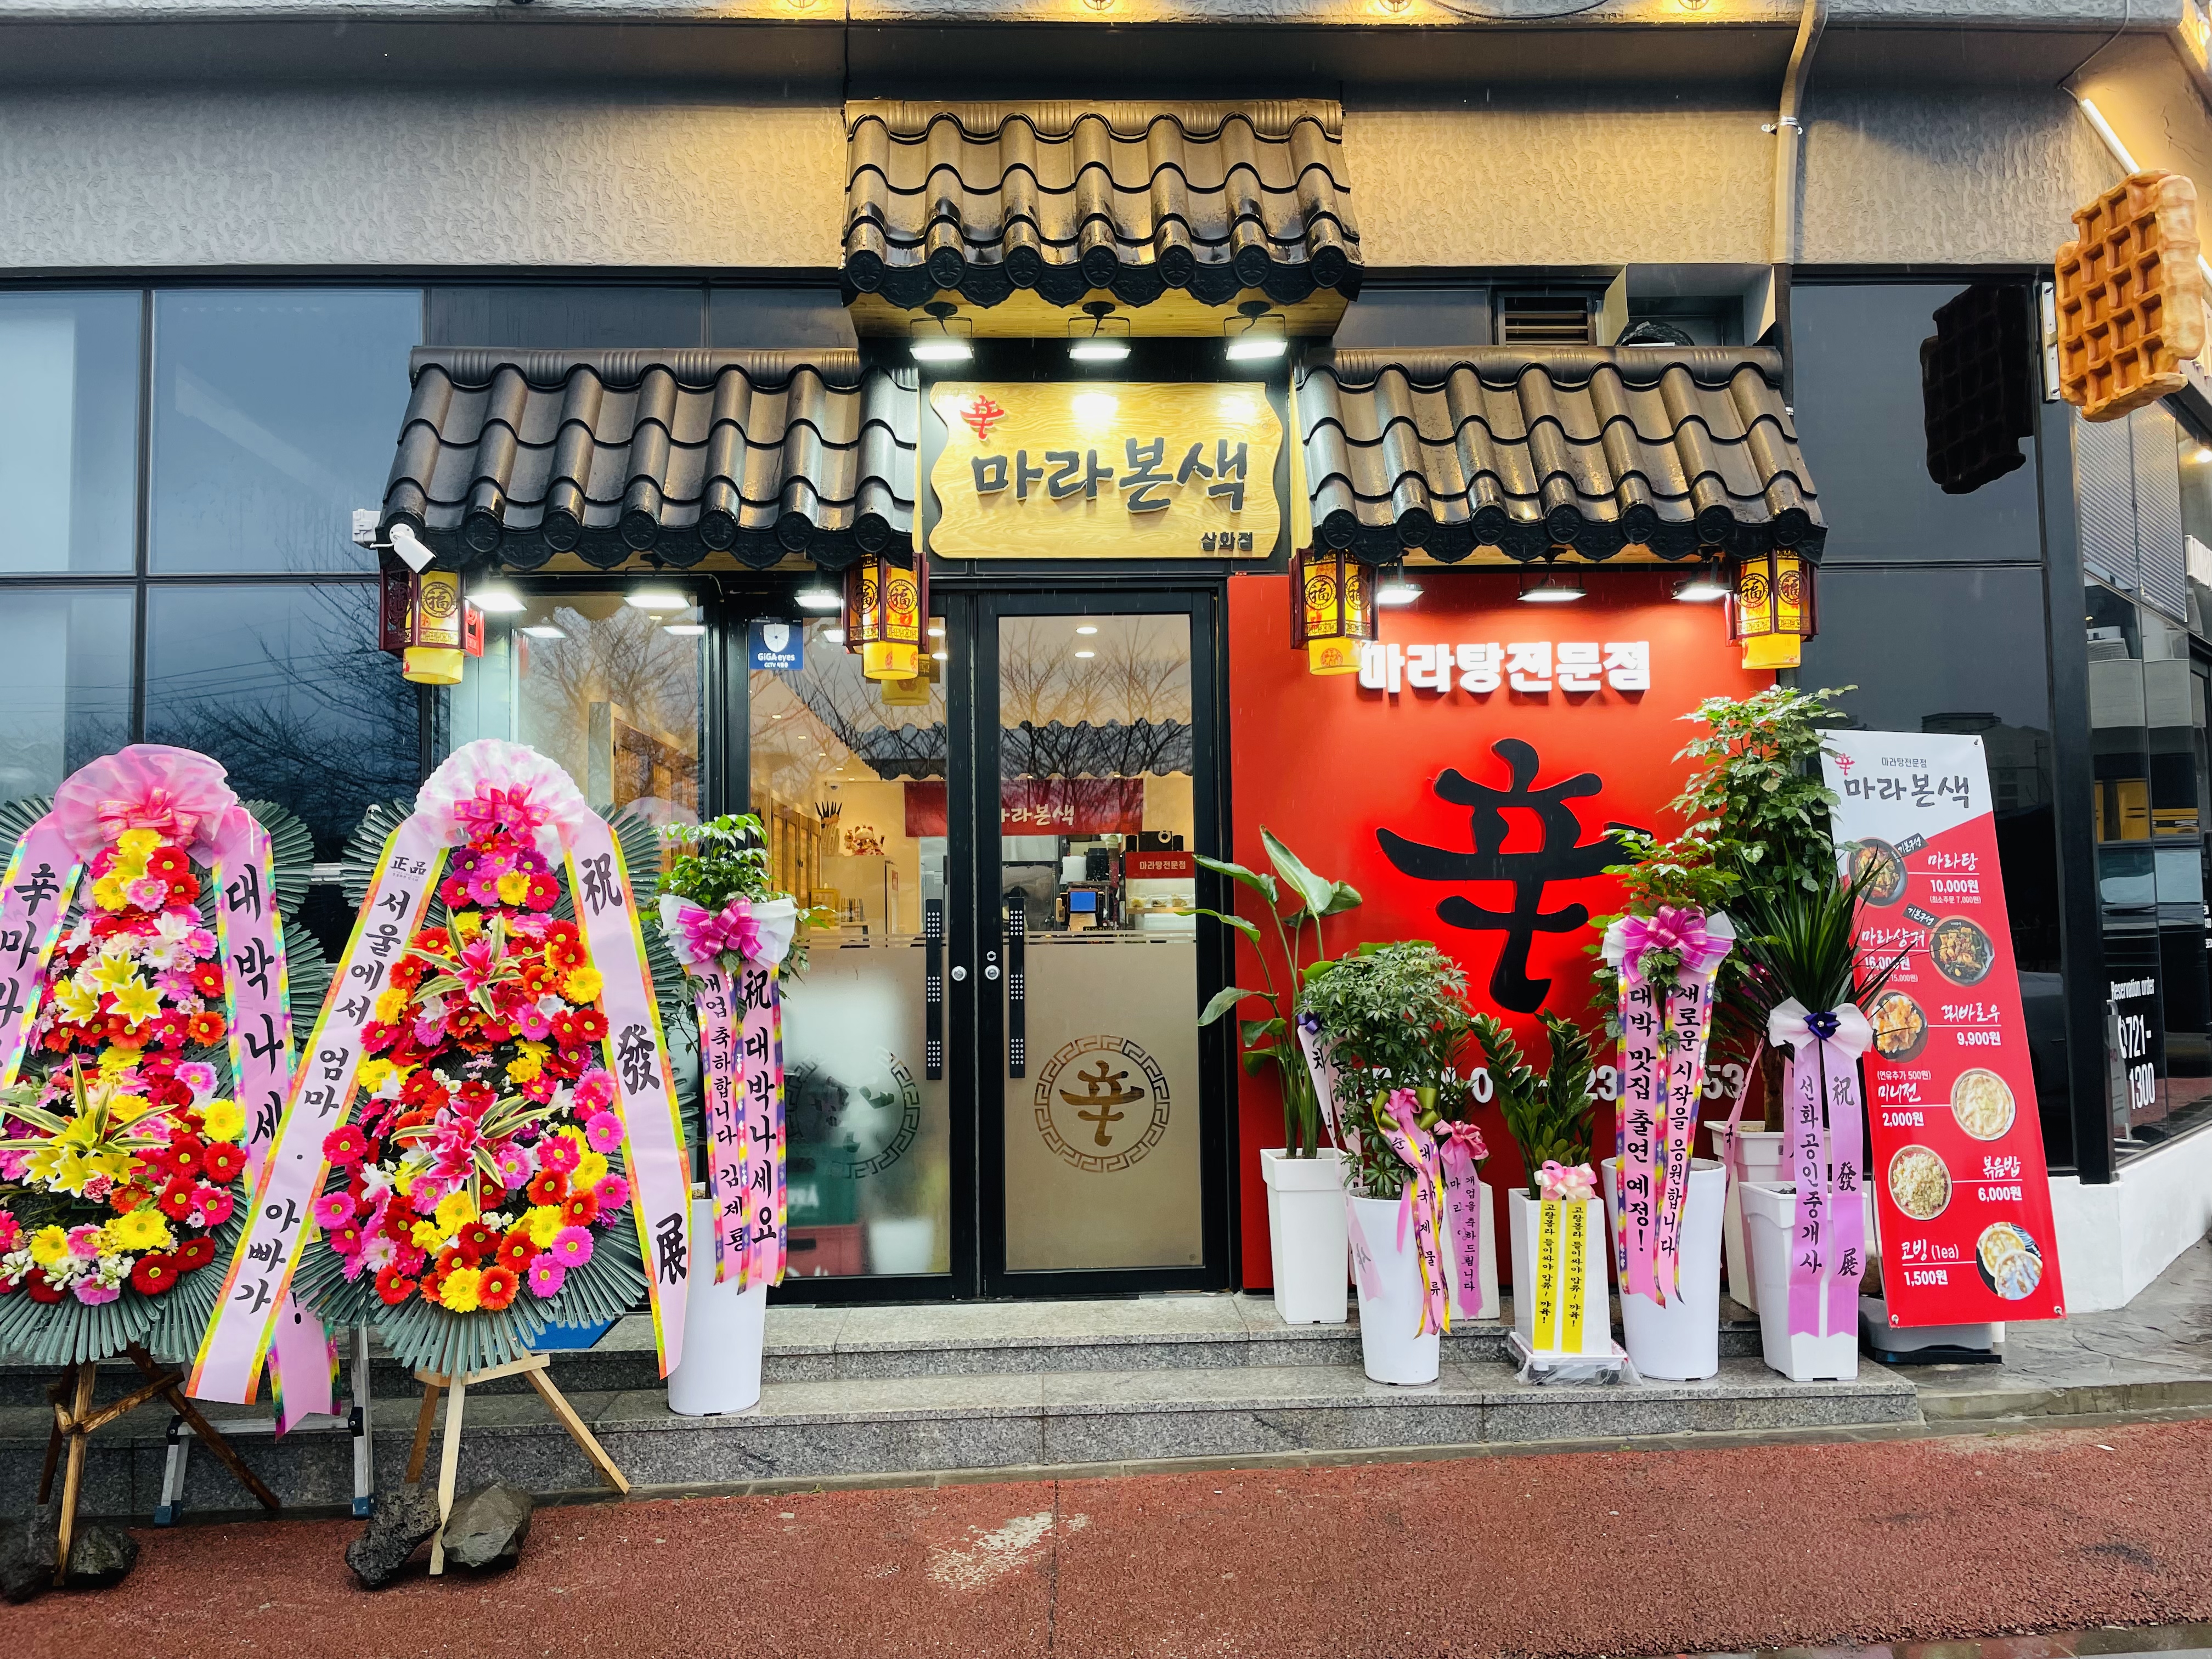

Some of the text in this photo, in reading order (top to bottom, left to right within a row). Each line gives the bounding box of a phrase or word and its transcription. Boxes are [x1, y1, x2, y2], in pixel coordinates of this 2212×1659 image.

[971, 437, 1247, 514] 마라본색
[1200, 532, 1252, 551] 삼화점
[1358, 641, 1650, 694] 마라탕전문점
[1882, 757, 1927, 769] 마라탕전문점
[1844, 774, 1970, 809] 마라본색
[1897, 836, 1922, 854] 기본구성
[390, 856, 427, 875] 正品
[1139, 859, 1187, 871] 마라탕전문점
[1927, 851, 1978, 872] 마라탕
[1930, 878, 1979, 894] 10,000원
[1908, 906, 1936, 927] 기본구성
[335, 889, 411, 1027] 서울에서
[2111, 977, 2155, 1001] Reservation order
[1940, 1002, 2001, 1024] 꿔바로우
[1956, 1031, 2001, 1046] 9,900원
[1877, 1070, 1932, 1081] (연유추가 500원)
[2129, 1062, 2156, 1110] 1300
[711, 1026, 737, 1147] 축하합니다
[1878, 1082, 1922, 1104] 미니전
[1626, 984, 1657, 1252] 대박 맛집 출연 예정!
[1661, 984, 1701, 1259] 새로운 시작을 응원합니다
[1882, 1111, 1925, 1127] 2,000원
[744, 1026, 777, 1244] 대박나세요
[1983, 1155, 2022, 1180] 볶음밥
[1978, 1186, 2023, 1203] 6,000원
[1464, 1176, 1476, 1293] 개업을 축하드립니다
[1931, 1243, 1959, 1261] (1ea)
[1903, 1269, 1949, 1287] 1,500원
